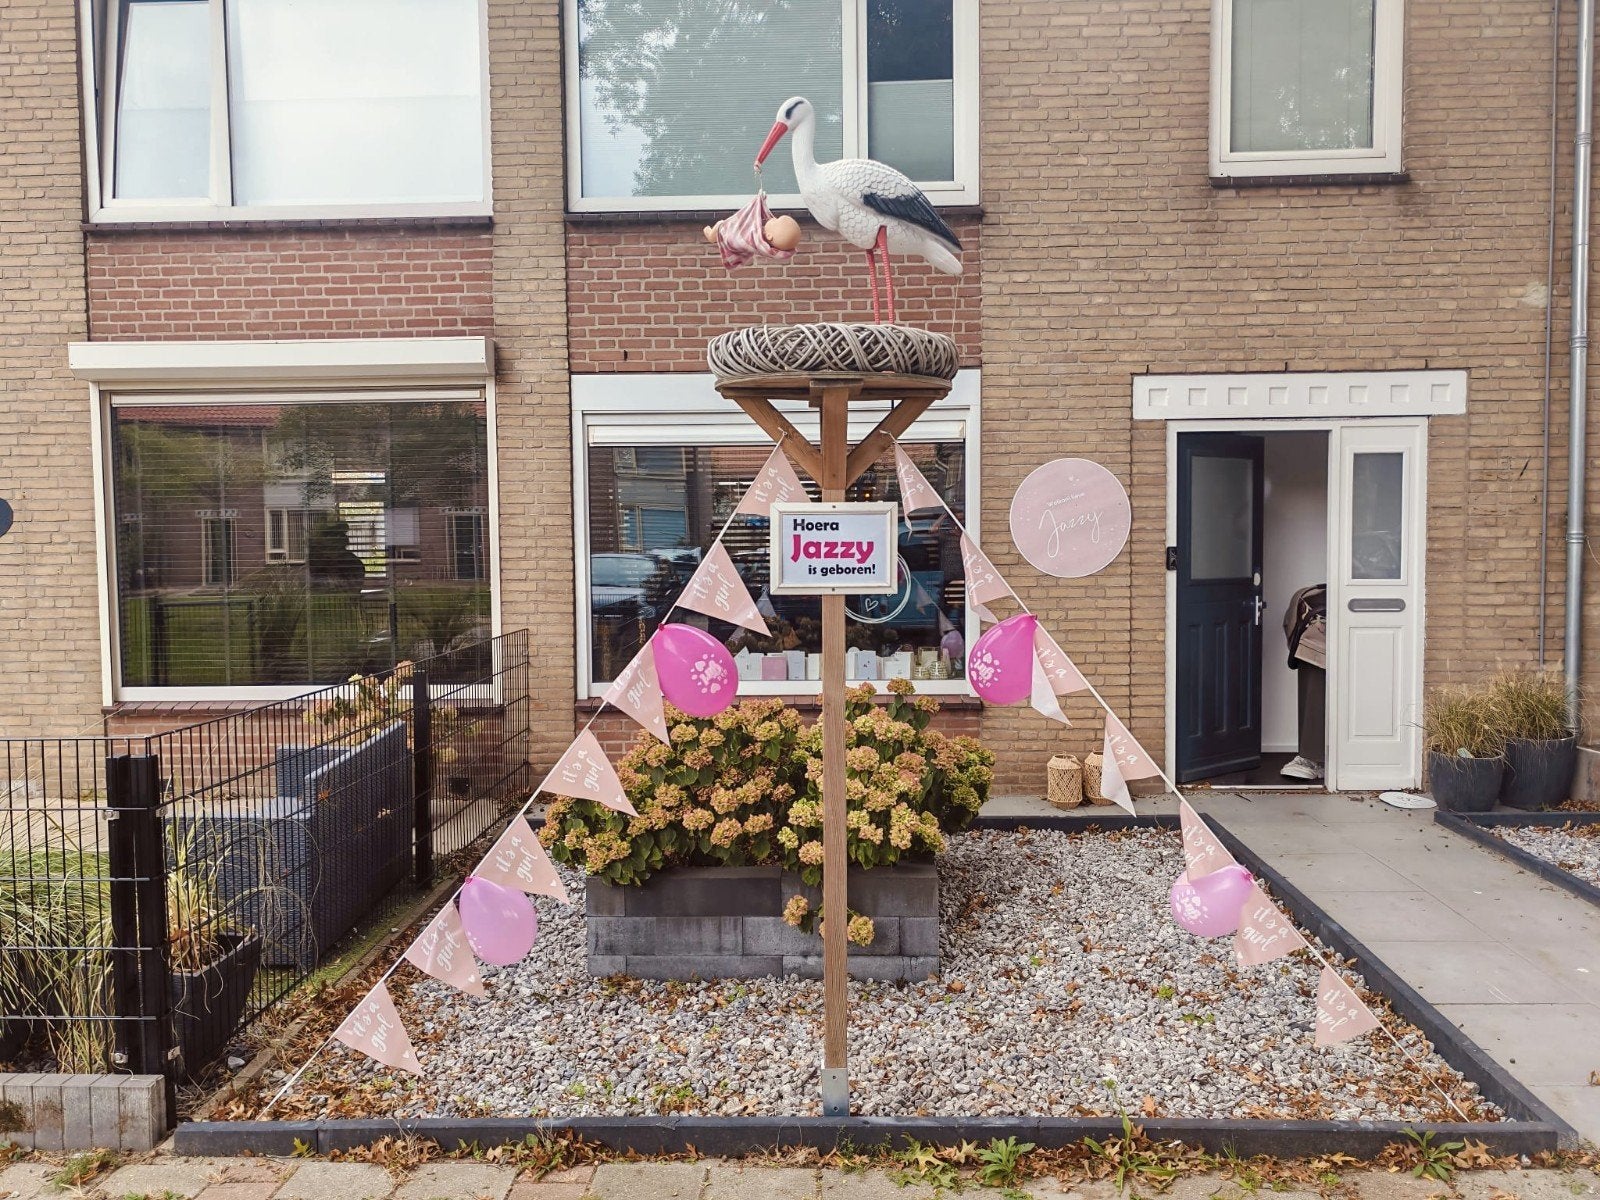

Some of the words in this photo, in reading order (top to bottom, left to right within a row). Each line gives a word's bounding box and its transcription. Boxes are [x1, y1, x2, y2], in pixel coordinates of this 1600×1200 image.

[768, 467, 778, 478] a
[793, 518, 839, 531] Hoera
[1038, 509, 1103, 558] Jazzy
[791, 534, 874, 565] Jazzy
[708, 561, 719, 574] a
[809, 564, 817, 575] is
[820, 563, 876, 577] geboren!
[714, 572, 735, 612] girl
[628, 668, 651, 710] girl
[562, 763, 582, 783] it's
[577, 749, 588, 760] a
[583, 757, 604, 792] girl
[496, 850, 516, 873] it's
[511, 835, 522, 847] a
[516, 846, 538, 883] girl
[1205, 844, 1216, 856] a
[1253, 906, 1279, 929] it's
[1278, 927, 1288, 938] a
[436, 930, 461, 972] girl
[1241, 926, 1279, 951] girl
[369, 1001, 380, 1013] a
[1322, 989, 1347, 1011] it's
[1347, 1009, 1358, 1020] a
[371, 1012, 394, 1052] girl
